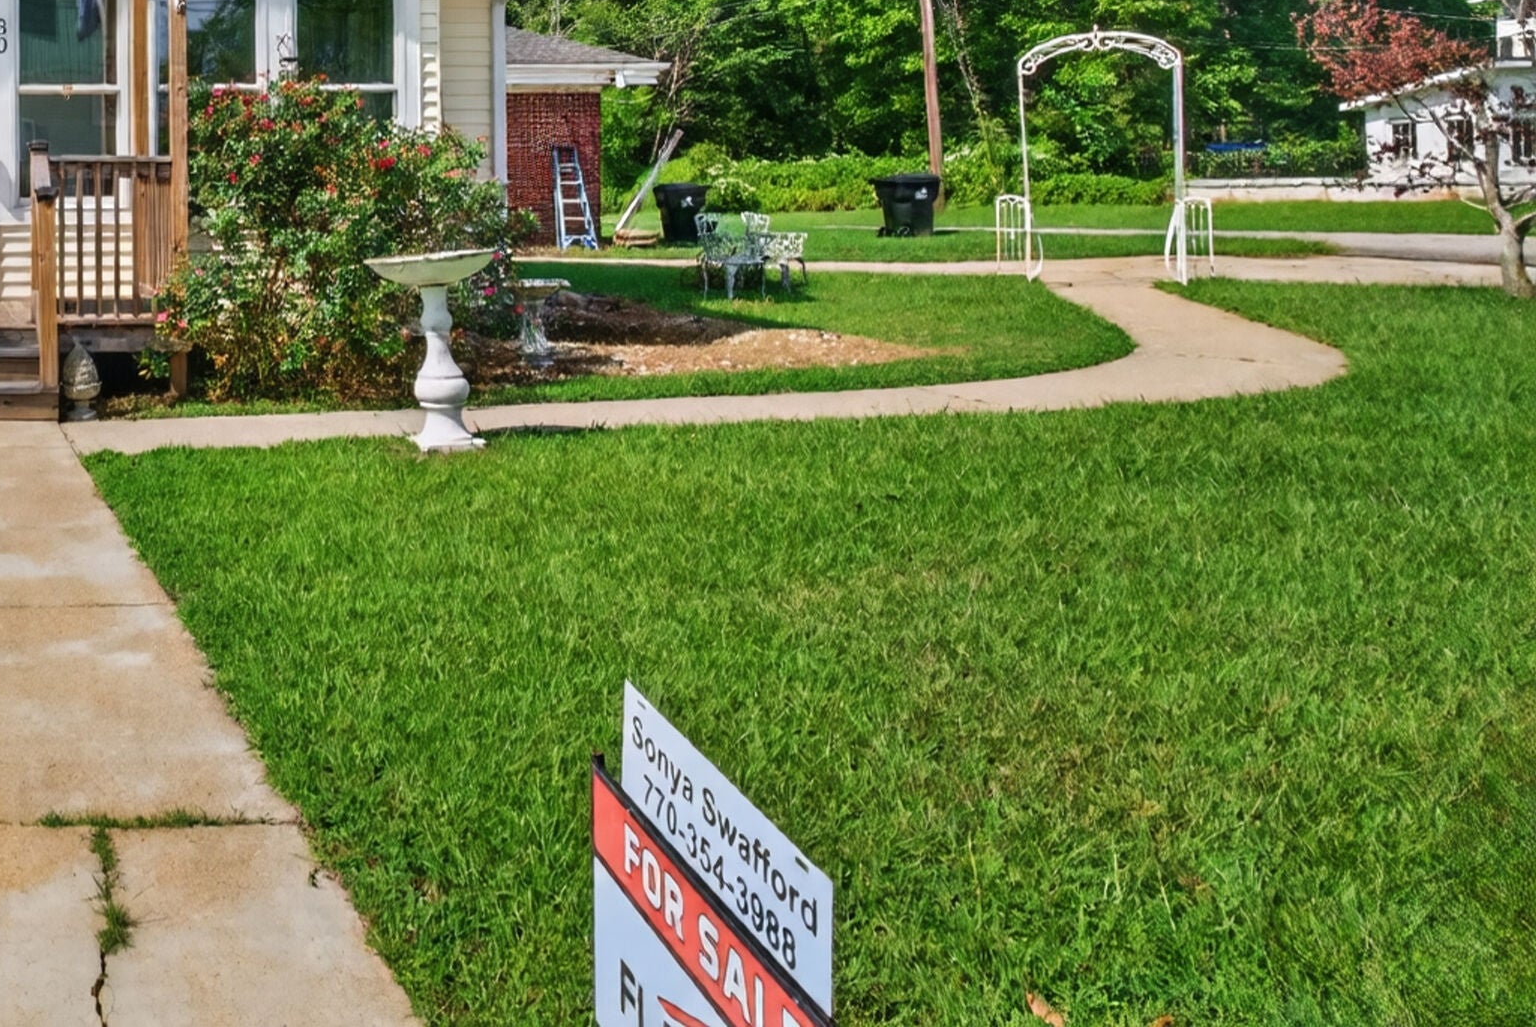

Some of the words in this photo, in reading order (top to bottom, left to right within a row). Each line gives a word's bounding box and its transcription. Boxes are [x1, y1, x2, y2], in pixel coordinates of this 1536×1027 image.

[623, 822, 685, 943] FOR
[632, 716, 693, 803] Sonya
[702, 788, 818, 938] Swafford
[643, 774, 797, 972] 770-354-3988
